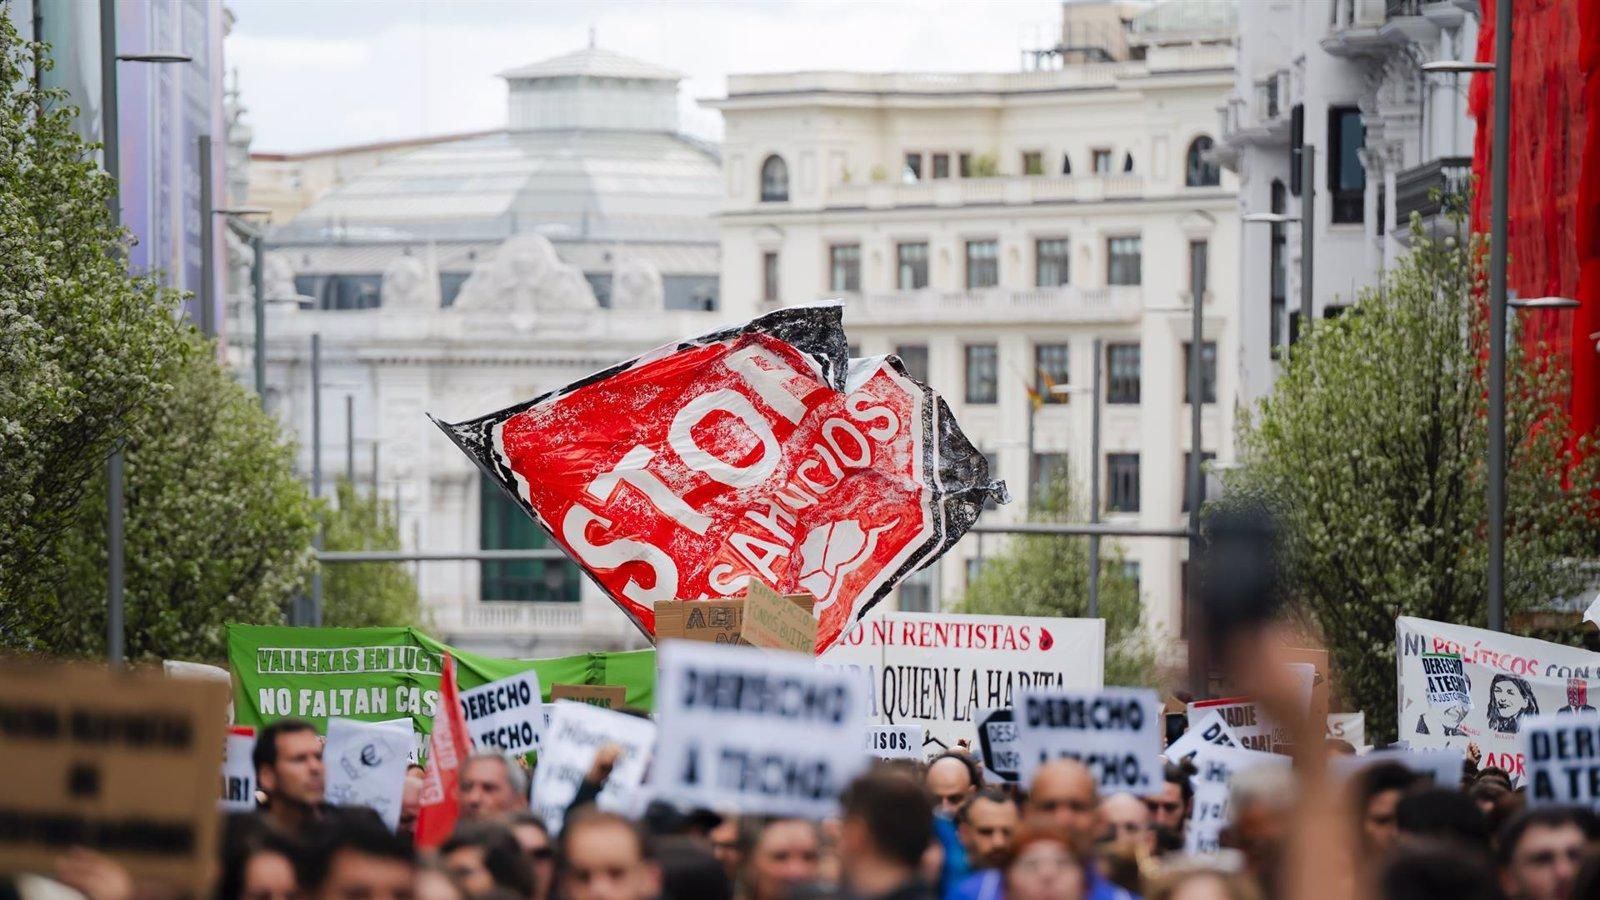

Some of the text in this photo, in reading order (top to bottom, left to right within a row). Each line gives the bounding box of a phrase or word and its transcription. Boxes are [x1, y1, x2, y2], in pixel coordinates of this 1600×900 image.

[872, 620, 894, 645] NI
[901, 622, 1032, 650] RENTISTAS
[1404, 632, 1425, 656] NI
[258, 650, 359, 672] VALLEKAS
[364, 649, 389, 669] EN
[259, 688, 292, 716] NO
[299, 687, 387, 717] FALTAN
[883, 665, 947, 724] QUIEN
[952, 667, 979, 721] LA
[1027, 697, 1143, 731] DERECHO
[1532, 732, 1600, 761] DER
